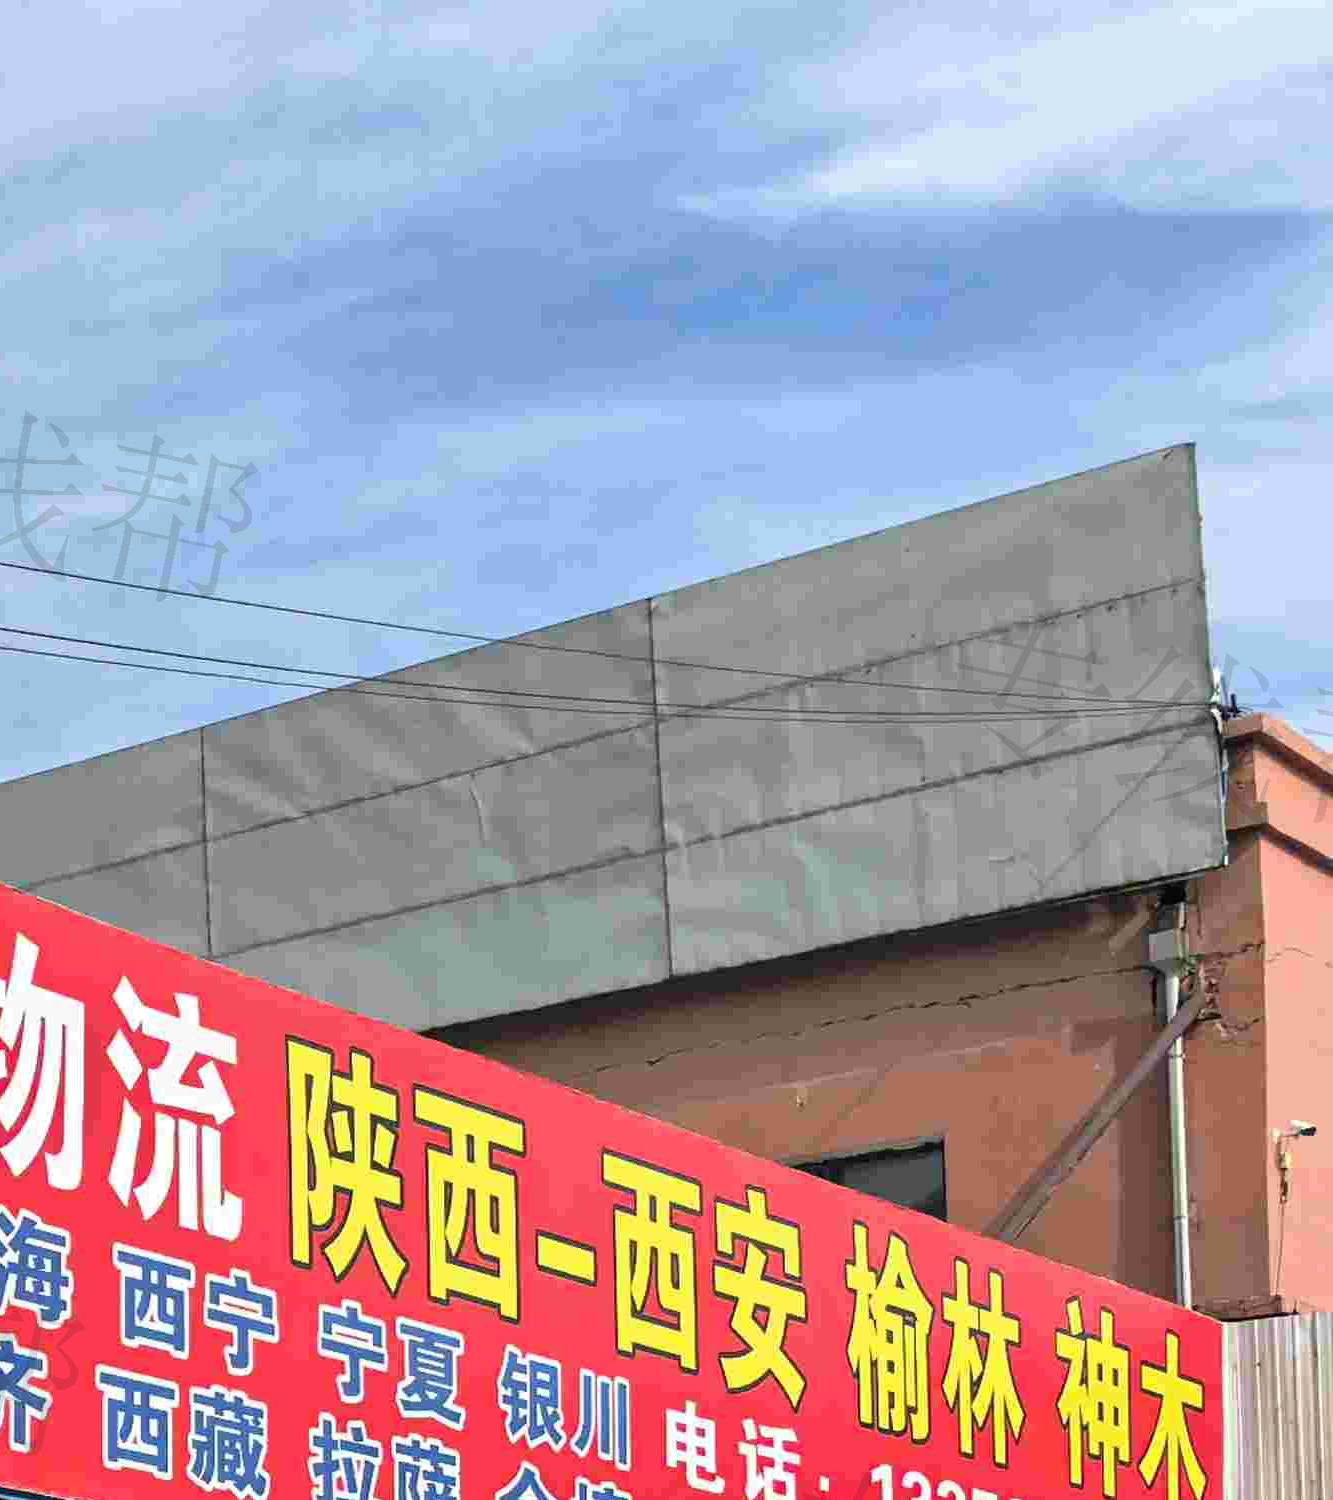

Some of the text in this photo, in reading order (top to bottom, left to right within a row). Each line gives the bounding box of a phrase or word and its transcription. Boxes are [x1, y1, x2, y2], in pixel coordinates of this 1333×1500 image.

[112, 1242, 280, 1376] 西宁
[317, 1299, 466, 1431] 宁夏
[497, 1344, 631, 1471] 银川
[844, 1221, 1025, 1468] 榆林
